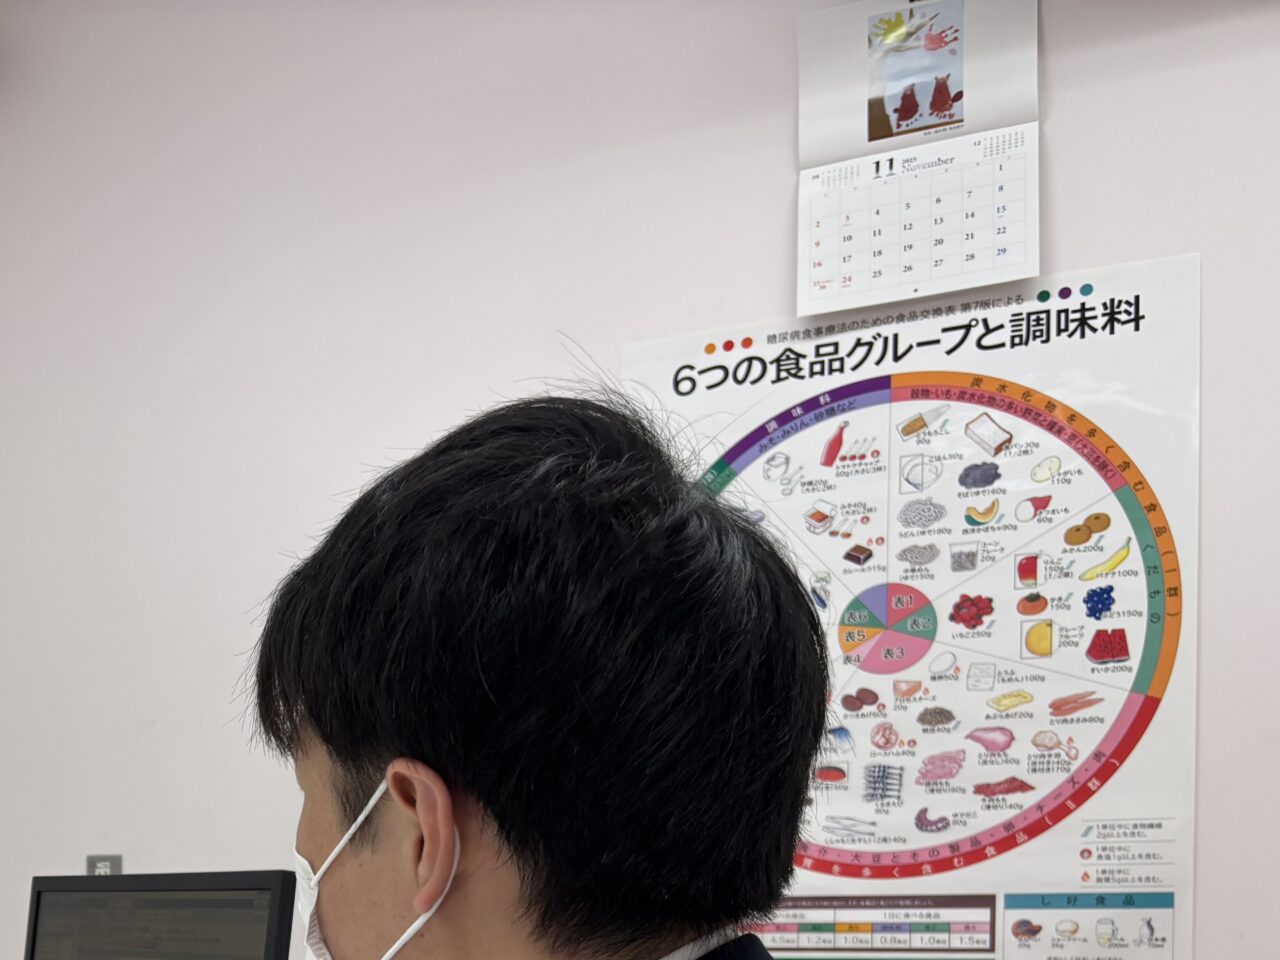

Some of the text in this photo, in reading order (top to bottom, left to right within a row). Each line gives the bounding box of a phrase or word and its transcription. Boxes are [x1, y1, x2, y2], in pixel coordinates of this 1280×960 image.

[872, 157, 896, 179] 11
[902, 156, 956, 174] November
[815, 220, 820, 228] 2
[845, 214, 850, 222] 3
[875, 208, 880, 216] 4
[936, 197, 941, 205] 6
[815, 205, 1006, 248] 9 10 11 12 13 14 15
[812, 226, 1007, 269] 16 17 18 19 20 21 22
[842, 247, 1007, 284] 24 25 26 27 28 29
[766, 294, 1024, 344] 糖尿病食事療法のための食品交換表 第7版による
[672, 294, 1145, 397] 6つの食品グループと調味料
[758, 399, 857, 454] みそ・みりん・砂糖など
[765, 393, 831, 433] 調味料
[1061, 544, 1104, 554] みかん200g
[1142, 544, 1161, 625] くだもの
[893, 595, 913, 609] 表1
[845, 630, 866, 642] 表5
[909, 618, 932, 630] 表2
[843, 647, 905, 665] 表4 表3
[1057, 640, 1079, 648] 200g
